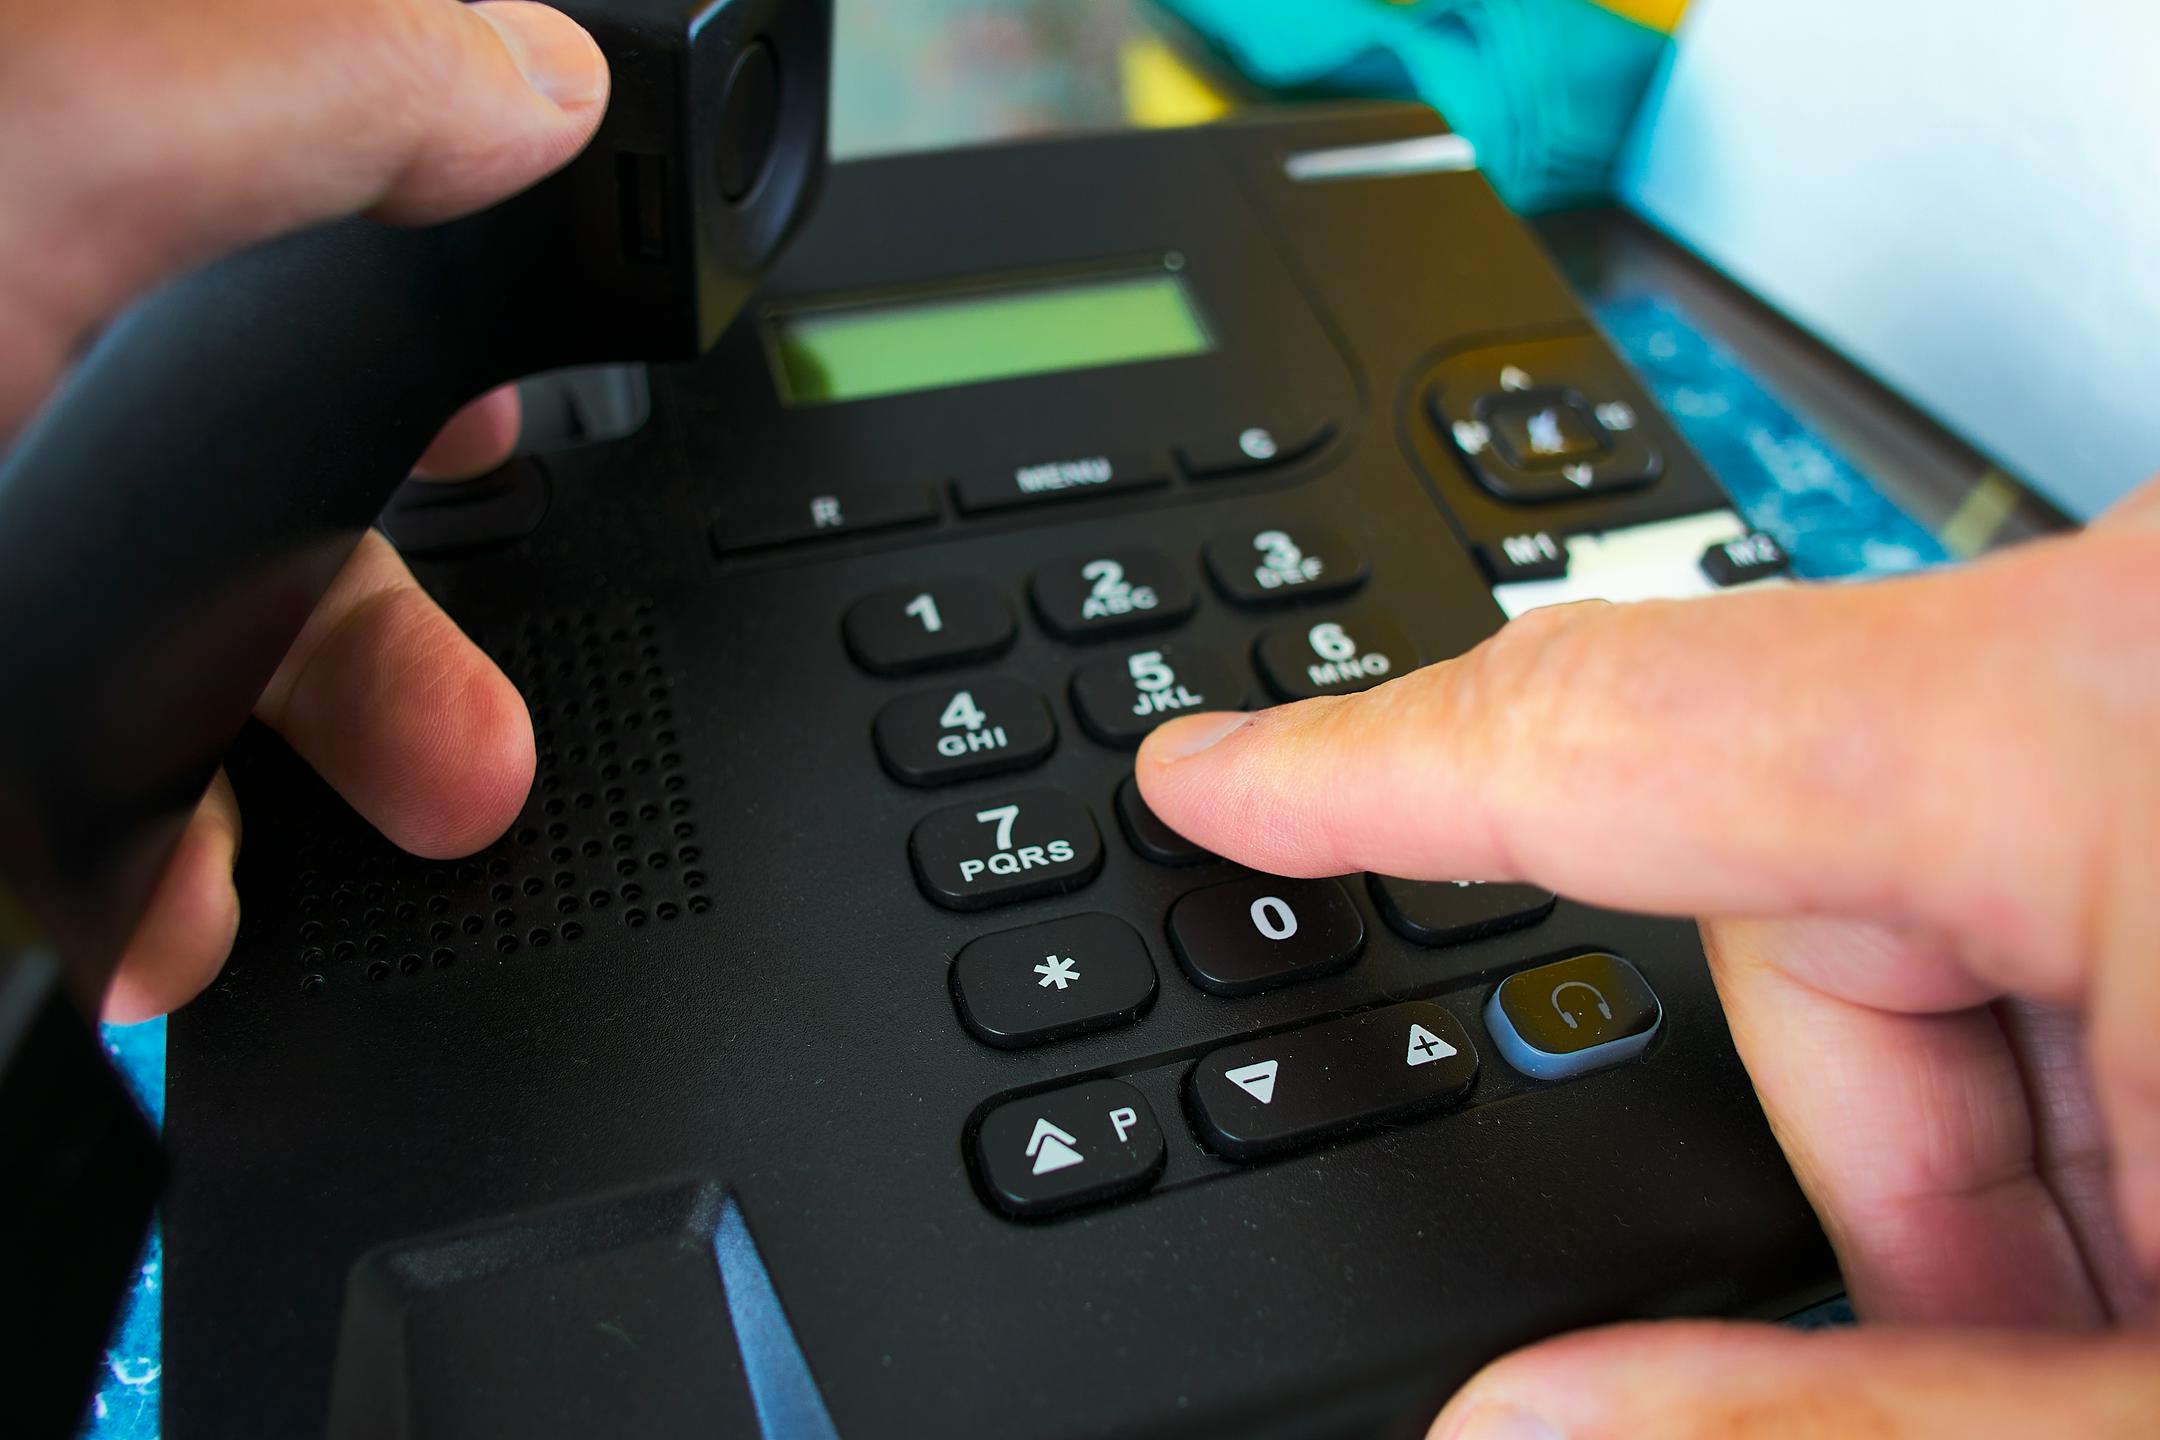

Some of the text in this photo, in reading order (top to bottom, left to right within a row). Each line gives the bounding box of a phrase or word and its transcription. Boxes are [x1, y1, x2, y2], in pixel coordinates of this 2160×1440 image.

[1016, 457, 1112, 492] MENU
[810, 497, 842, 527] R
[1253, 530, 1304, 572] 3
[1082, 560, 1133, 601] 2
[1255, 554, 1322, 589] DEF
[906, 594, 942, 632] 1
[1081, 586, 1158, 619] ABC
[1308, 622, 1356, 662] 6
[1128, 651, 1175, 694] 5
[1307, 651, 1391, 686] MNO
[940, 691, 986, 731] 4
[1132, 685, 1203, 716] JKL
[937, 726, 1008, 757] GHI
[976, 804, 1020, 851] 7
[959, 839, 1075, 883] PQRS
[1250, 896, 1298, 940] 0
[1109, 1107, 1138, 1143] P
